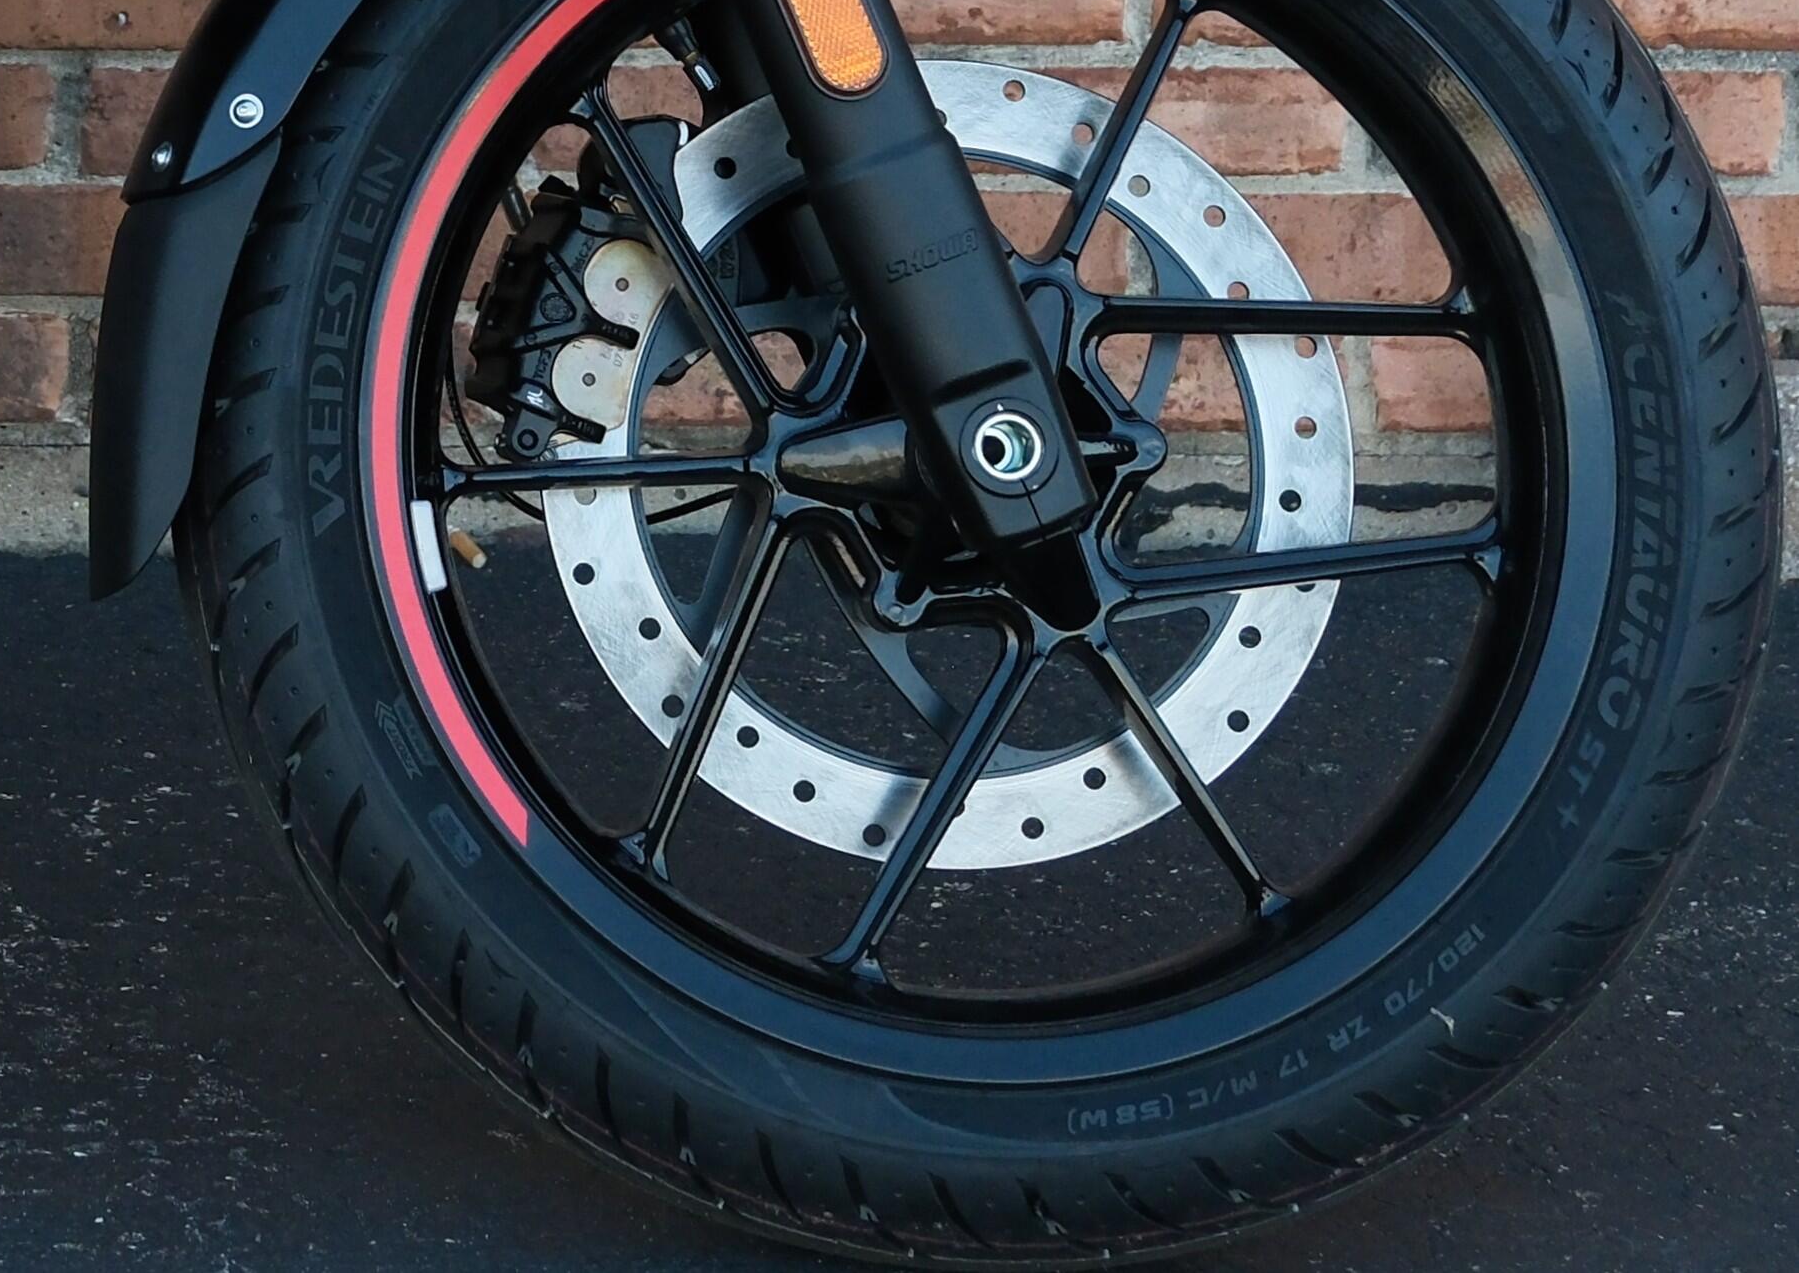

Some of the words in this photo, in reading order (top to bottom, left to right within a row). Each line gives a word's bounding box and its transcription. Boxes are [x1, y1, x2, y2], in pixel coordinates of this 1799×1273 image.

[887, 226, 980, 284] SHOWA
[307, 145, 404, 539] VREDESTEIN
[1383, 925, 1487, 1018] 120/70
[1326, 1019, 1373, 1055] ZR
[1278, 1049, 1310, 1081] 17
[1189, 1070, 1260, 1114] M/C
